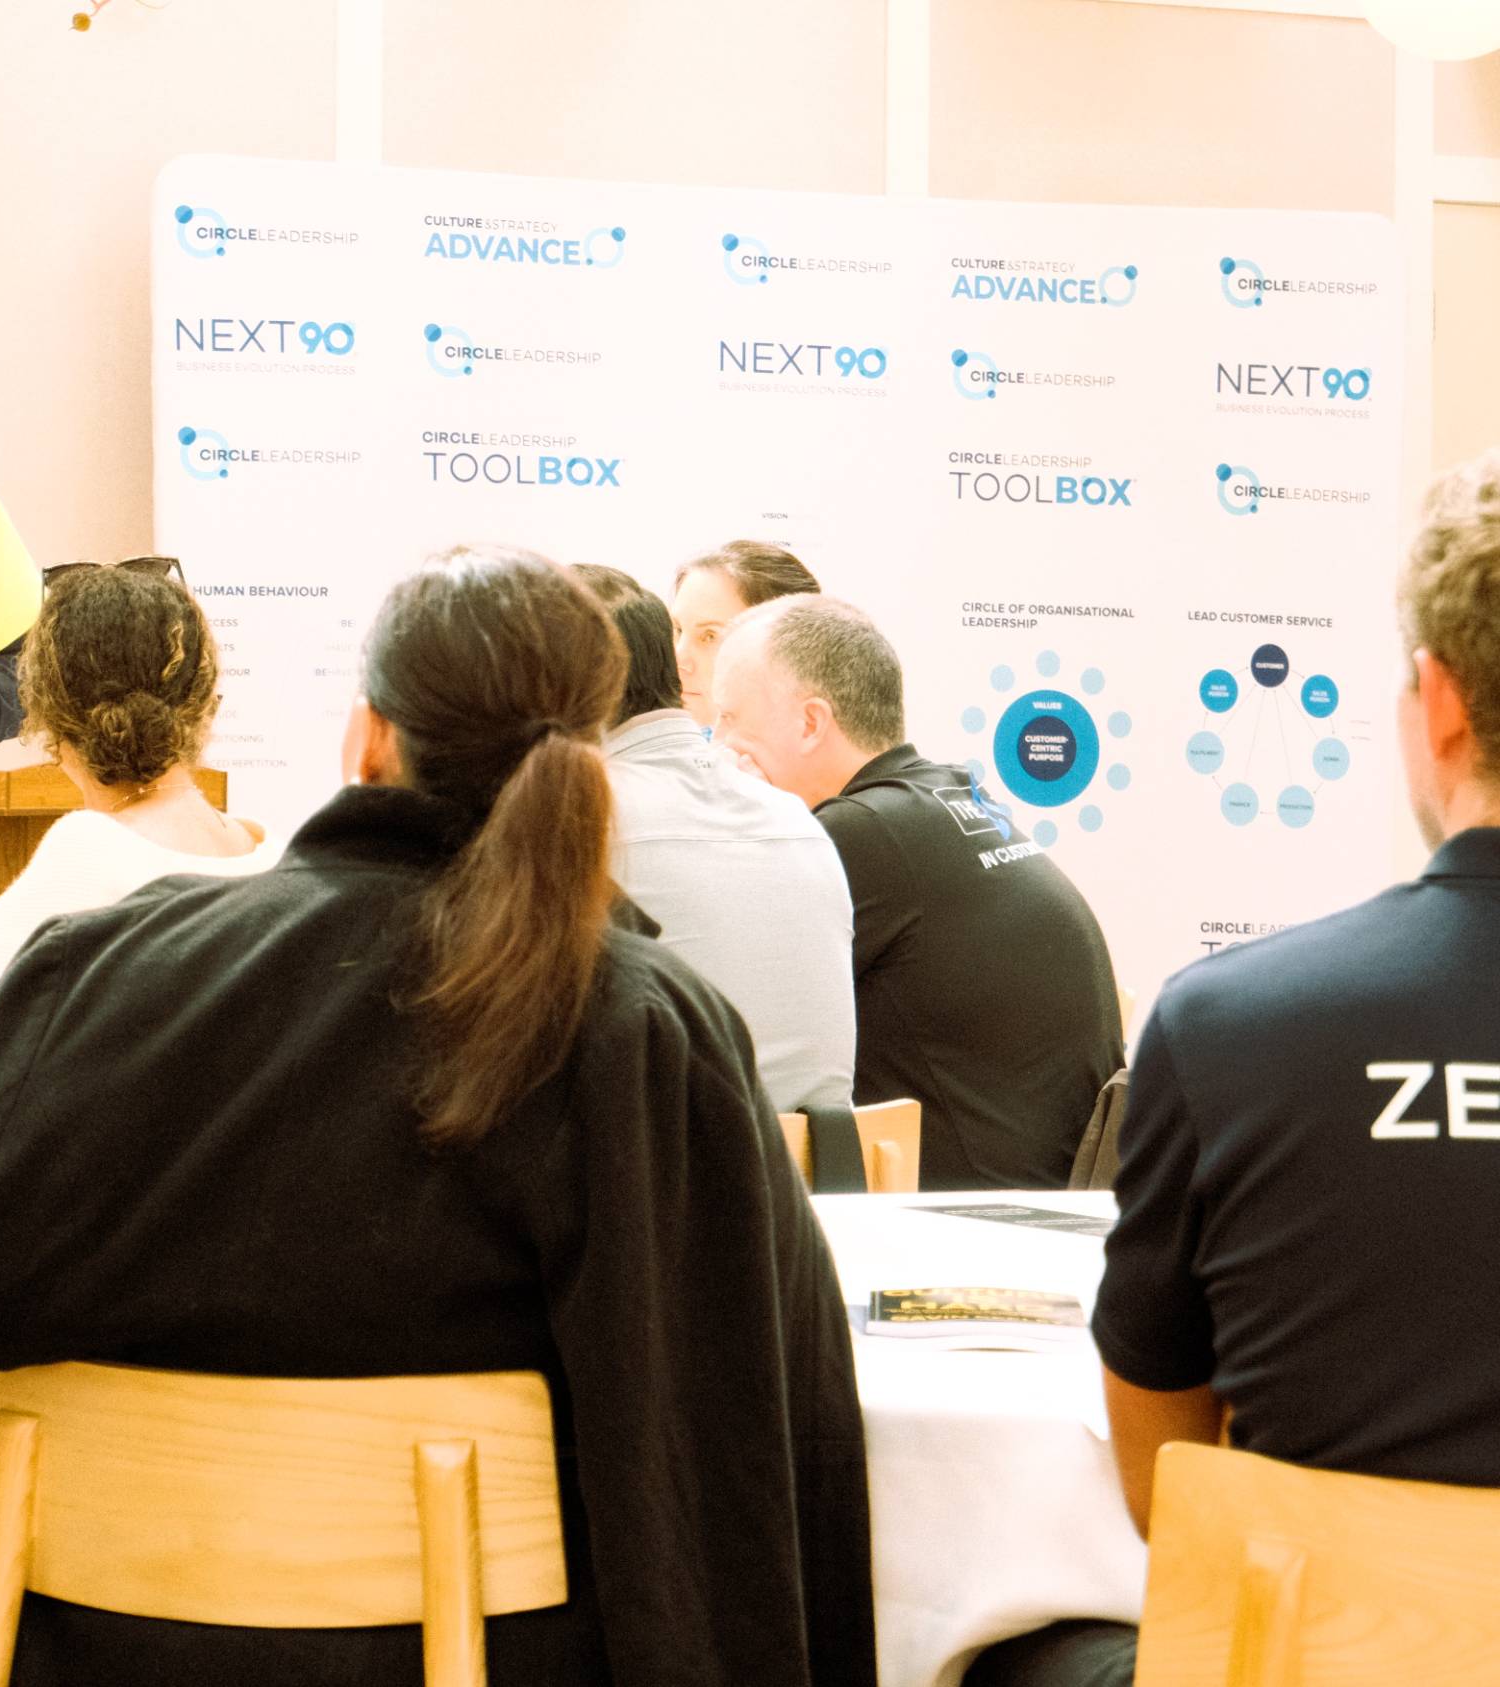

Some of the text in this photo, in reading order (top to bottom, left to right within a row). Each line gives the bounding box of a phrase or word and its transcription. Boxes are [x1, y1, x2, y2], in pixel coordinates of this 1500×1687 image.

[175, 318, 356, 356] NEXT90
[719, 340, 888, 380] NEXT90
[1216, 362, 1372, 401] NEXT90
[1267, 405, 1322, 416] EVOLUTION
[1324, 407, 1371, 419] PROCESS
[249, 585, 329, 598] BEHAVIOUR
[962, 602, 1136, 619] CIRCLE OF ORGANISATIONAL
[962, 616, 1038, 630] LEADERSHIP
[1187, 611, 1333, 629] LEAD CUSTOMER SERVICE
[978, 850, 998, 869] IN
[1365, 1060, 1500, 1140] ZE
